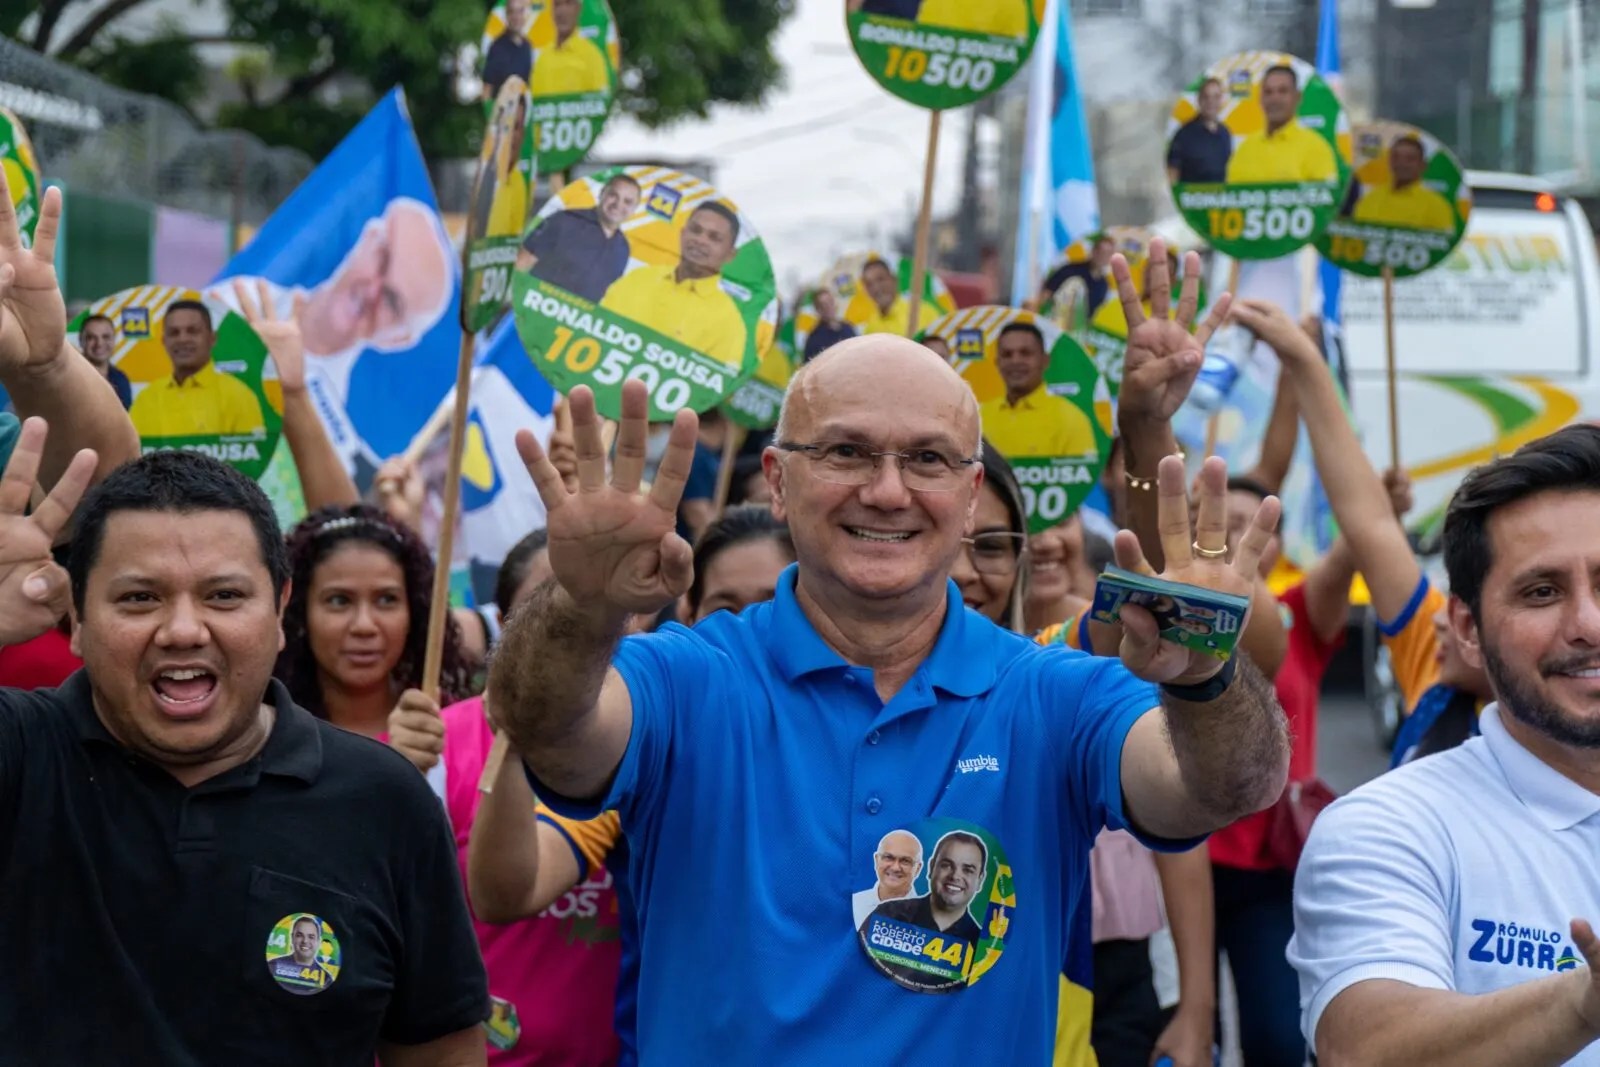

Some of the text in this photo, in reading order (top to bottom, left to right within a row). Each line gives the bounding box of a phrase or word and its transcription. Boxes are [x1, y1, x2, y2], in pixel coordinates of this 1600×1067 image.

[859, 23, 1018, 63] RONALDO SOUSA
[885, 47, 995, 91] 10500
[1179, 188, 1333, 209] RONALDO SOUSA
[1208, 208, 1314, 240] 10500
[1330, 235, 1430, 270] 10500
[523, 288, 643, 352] RONALDO
[643, 342, 724, 394] SOUSA
[1013, 464, 1092, 485] SOUSA
[873, 924, 925, 946] ROBERTO
[1468, 918, 1577, 972] ZURRA
[1498, 922, 1561, 944] RÔMULO
[884, 953, 920, 970] CORONEL
[922, 937, 963, 967] 44
[301, 967, 320, 981] 44
